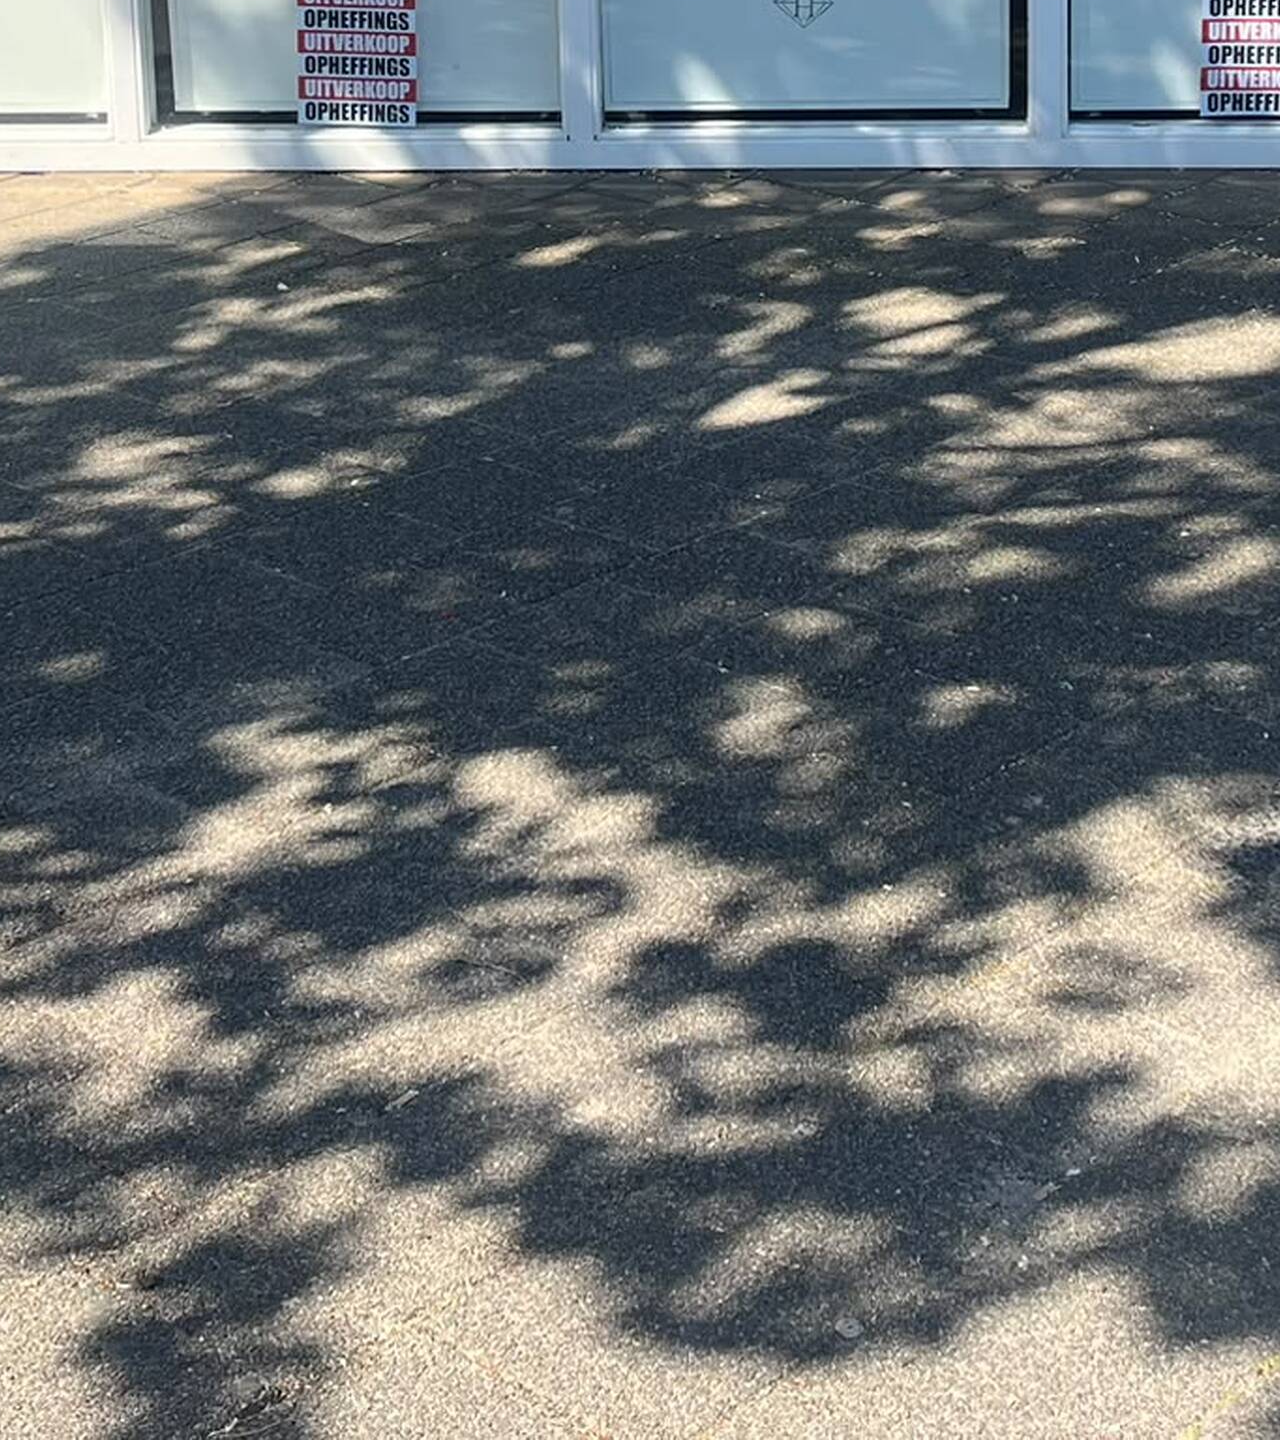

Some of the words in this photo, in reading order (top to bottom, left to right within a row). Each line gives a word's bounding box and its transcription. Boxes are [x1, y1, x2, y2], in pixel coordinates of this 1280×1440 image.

[304, 9, 410, 31] OPHEFFINGS
[303, 33, 410, 54] UITVERKOOP
[304, 55, 411, 77] OPHEFFINGS
[304, 79, 410, 100] UITVERKOOP
[305, 102, 410, 123] OPHEFFINGS
